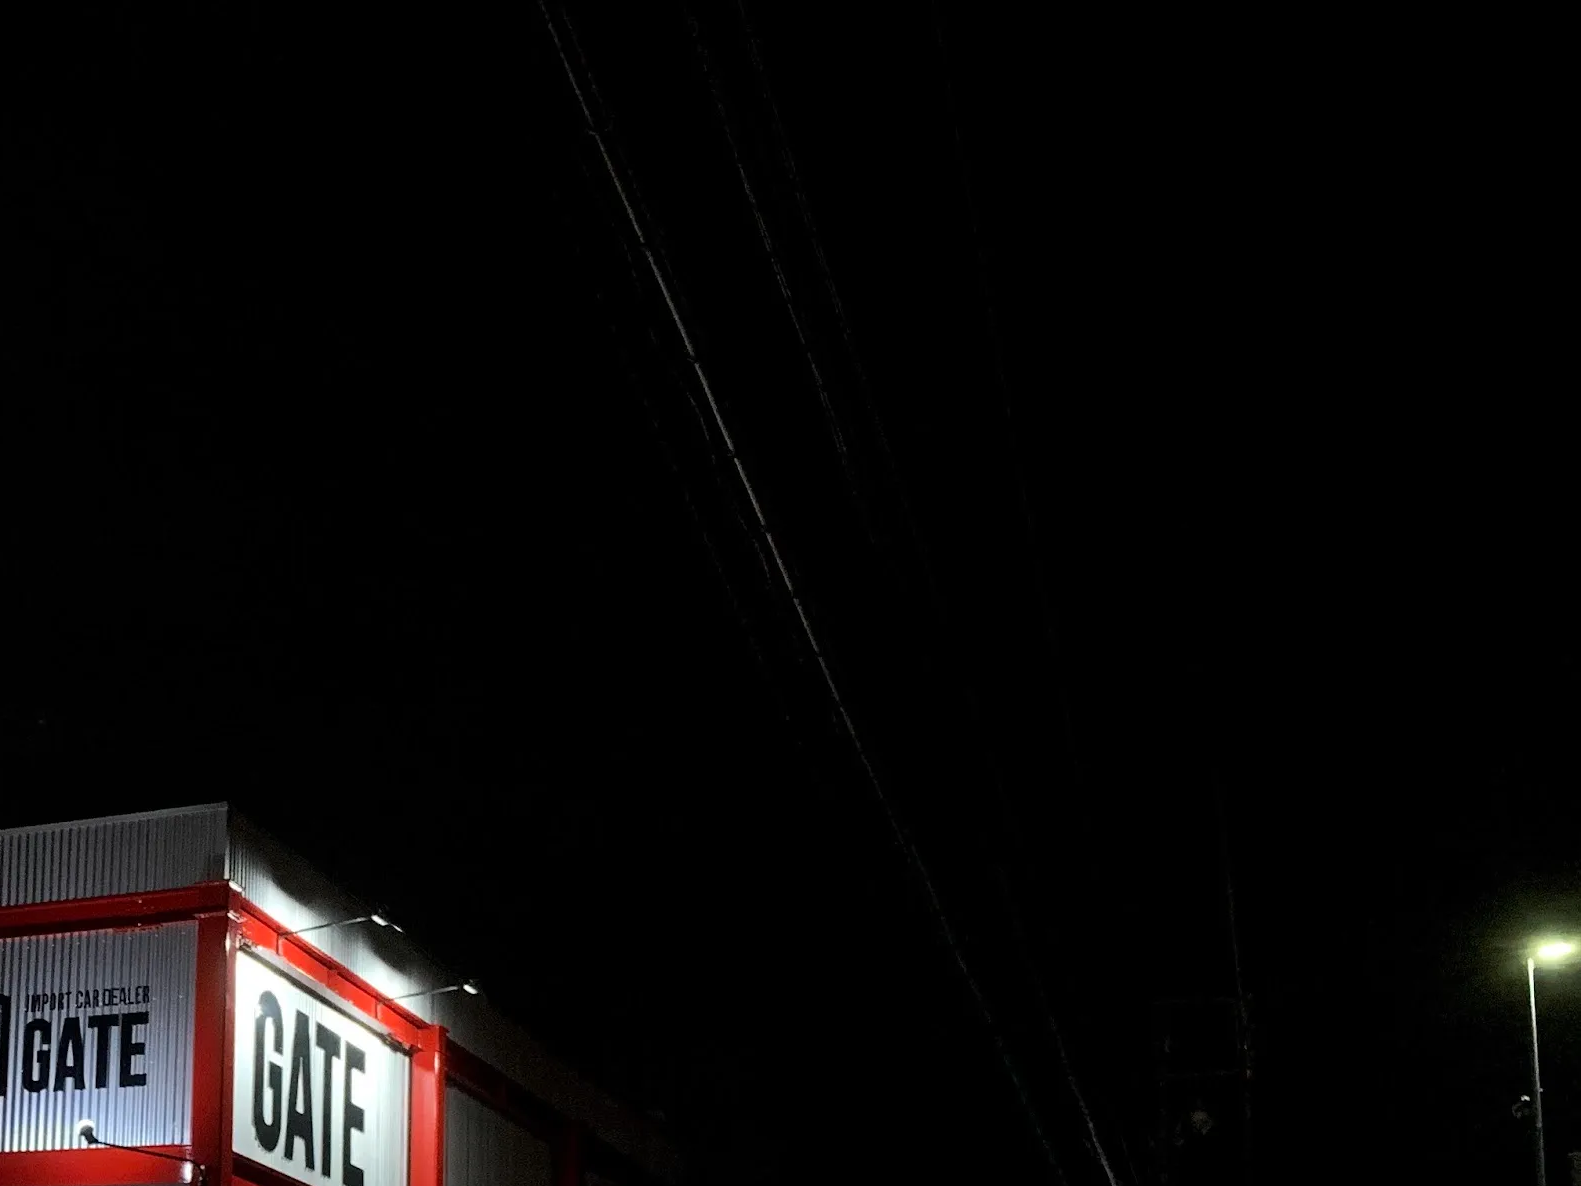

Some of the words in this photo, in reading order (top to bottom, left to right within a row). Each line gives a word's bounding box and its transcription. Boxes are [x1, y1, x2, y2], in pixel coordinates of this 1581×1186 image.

[25, 991, 72, 1013] IMPORT
[75, 989, 100, 1009] CAR
[102, 985, 150, 1006] DEALER
[21, 1011, 150, 1093] GATE
